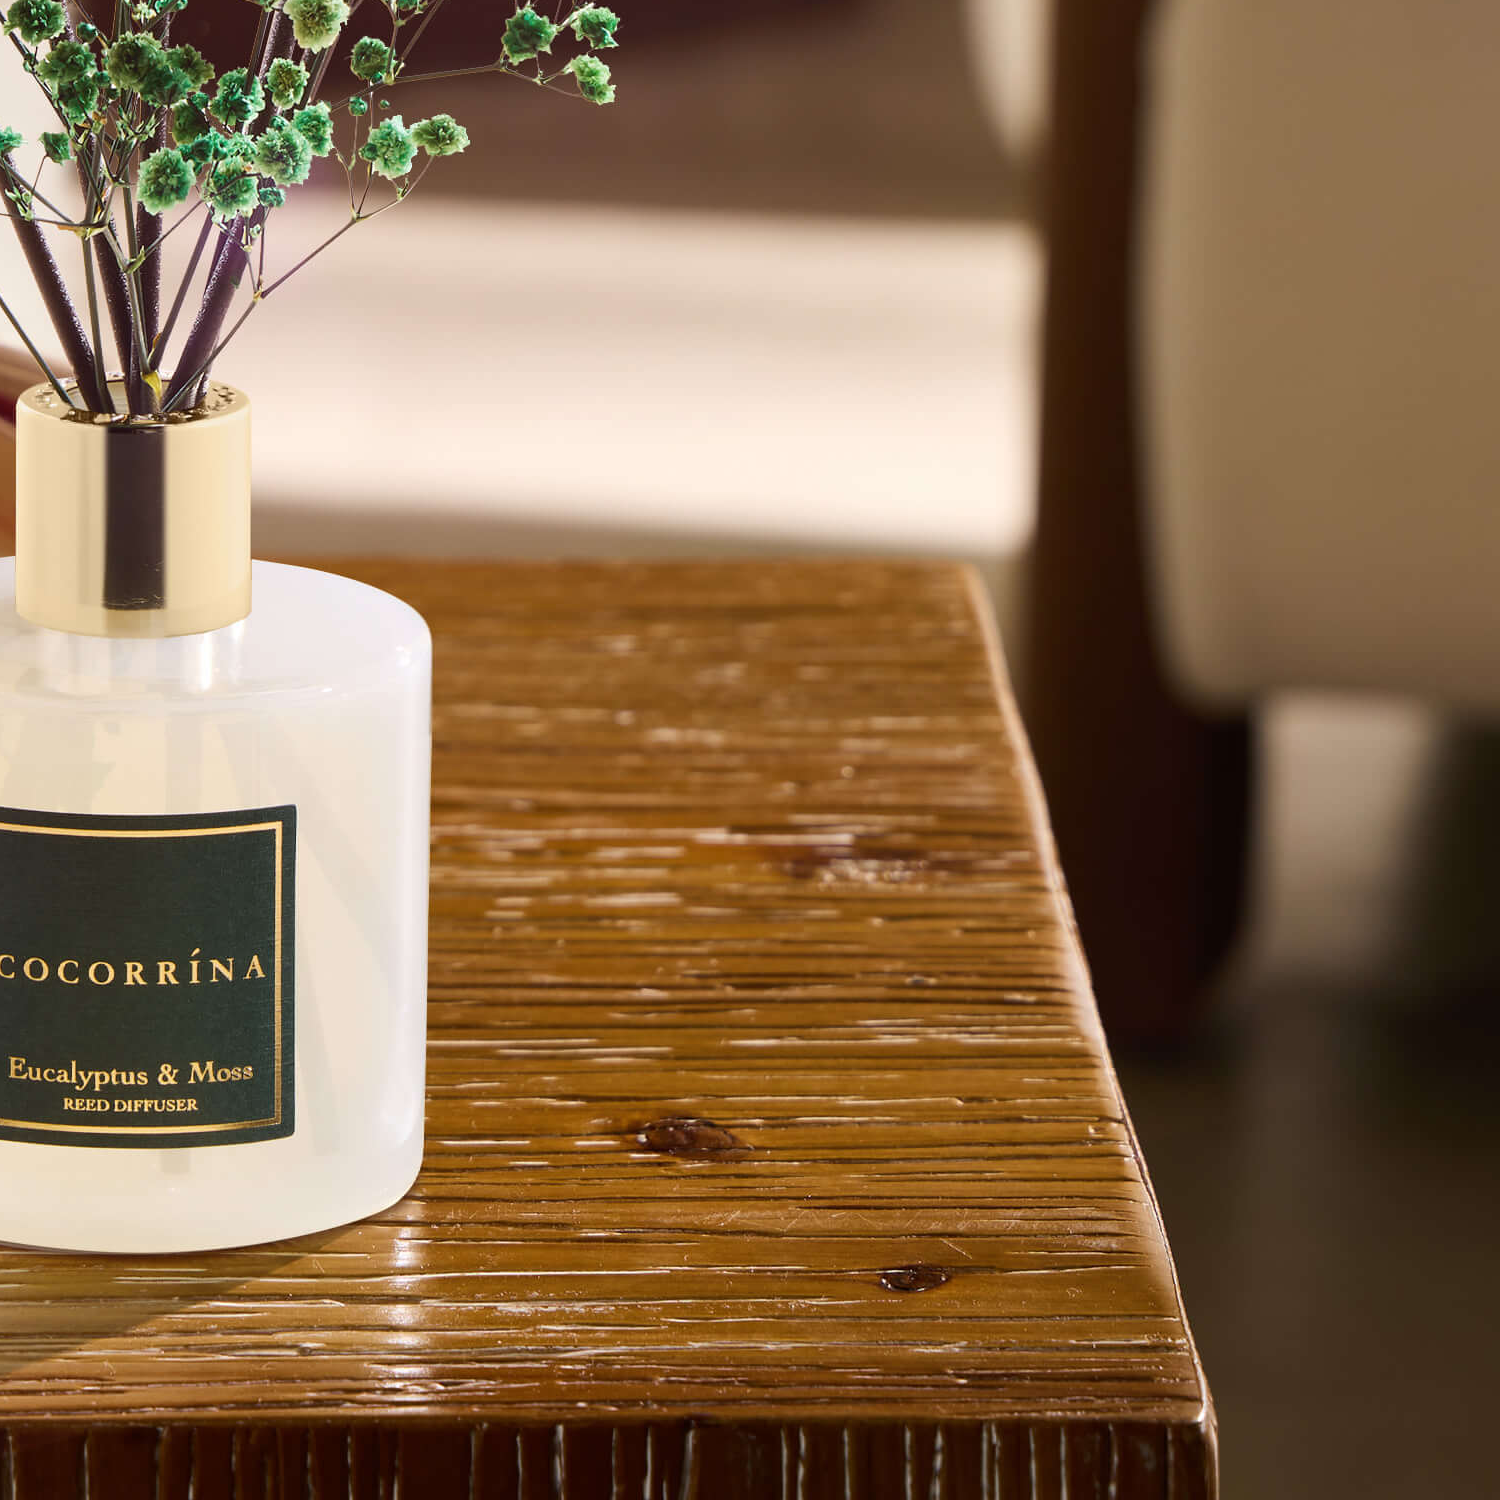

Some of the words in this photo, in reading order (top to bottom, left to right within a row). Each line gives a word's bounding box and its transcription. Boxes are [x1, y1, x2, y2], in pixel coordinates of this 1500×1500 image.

[8, 1056, 149, 1091] Eucalyptus
[157, 1063, 179, 1085] &
[188, 1061, 254, 1084] Moss
[63, 1097, 110, 1112] REED
[114, 1098, 198, 1113] DIFFUSER
